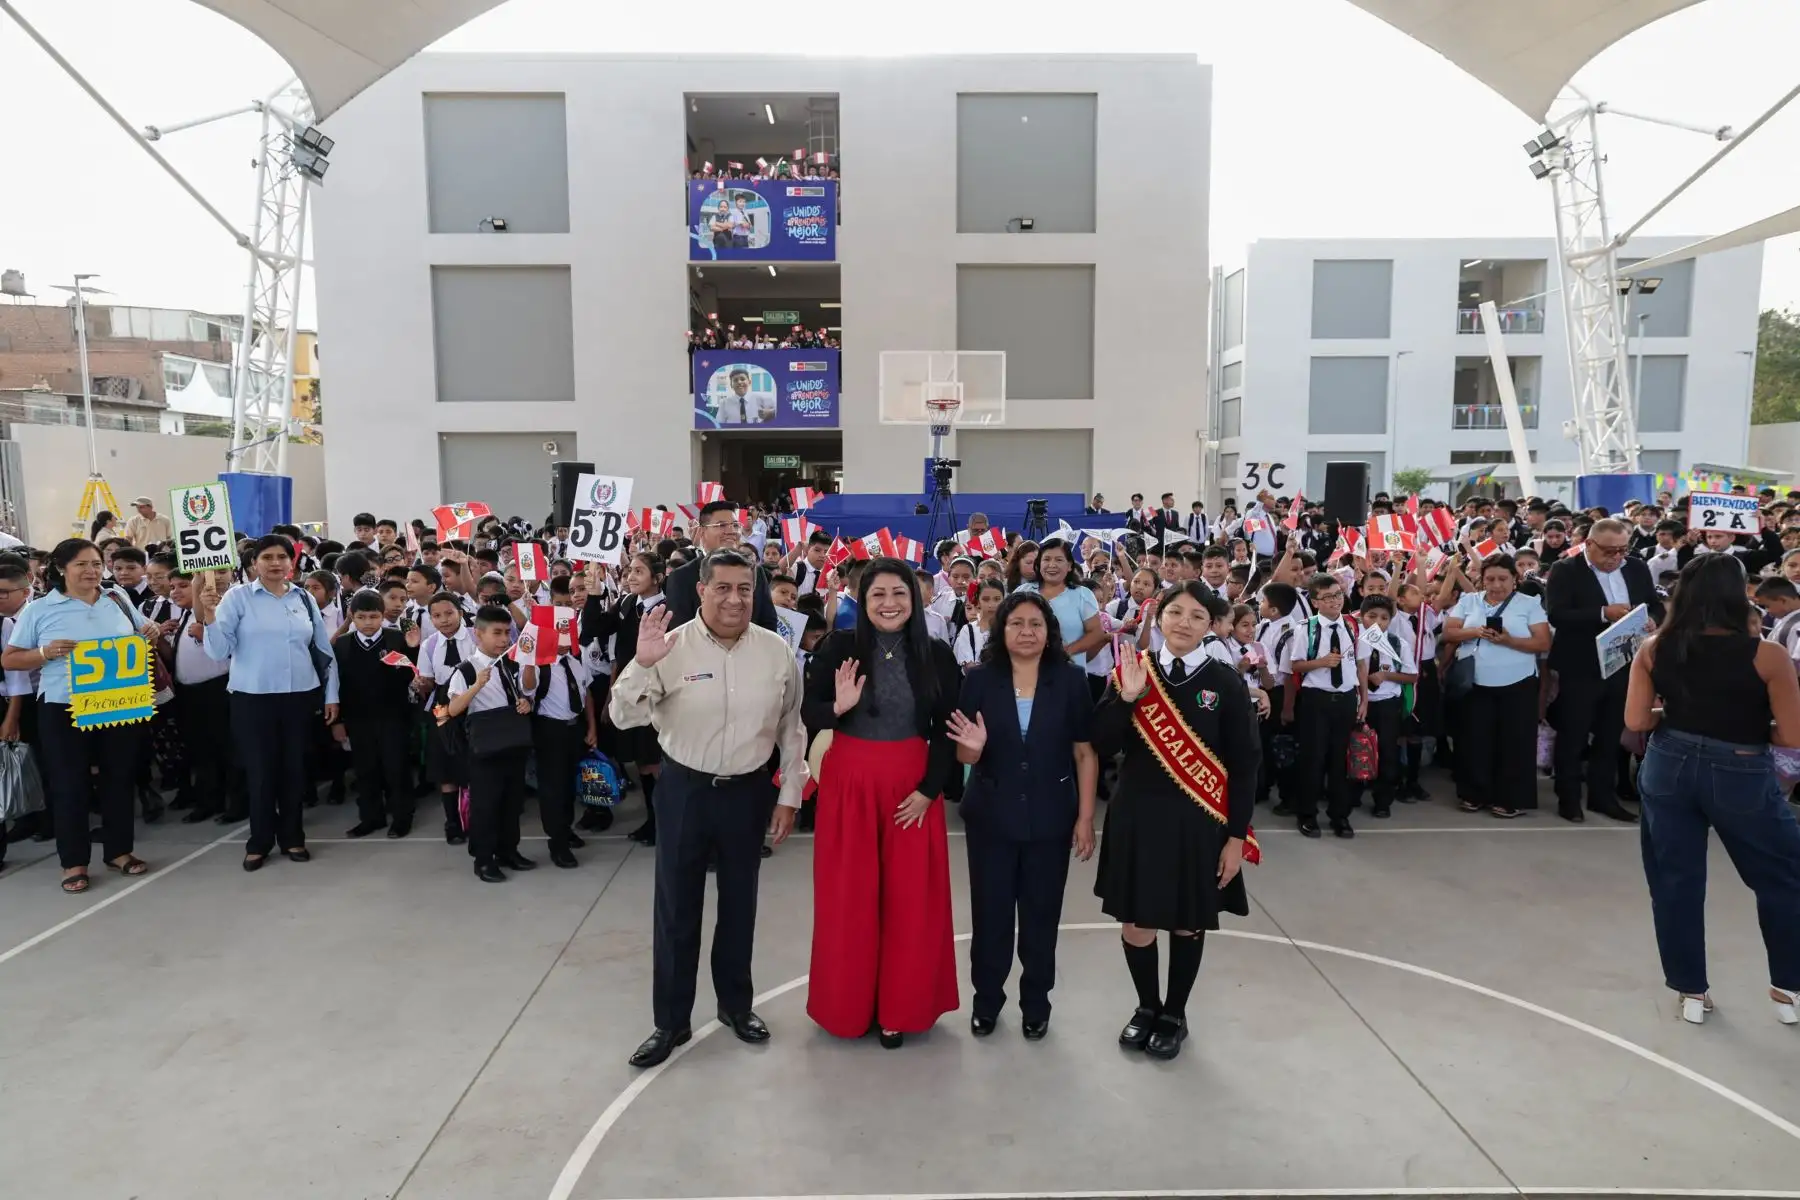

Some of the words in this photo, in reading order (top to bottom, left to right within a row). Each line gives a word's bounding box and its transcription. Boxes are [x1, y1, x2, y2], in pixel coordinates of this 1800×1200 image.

[1692, 495, 1759, 511] BIENVENIDOS
[182, 553, 231, 570] PRIMARIA
[580, 551, 606, 560] PRIMARIA
[79, 692, 150, 713] Primaria
[1140, 702, 1224, 804] ALCALDESA
